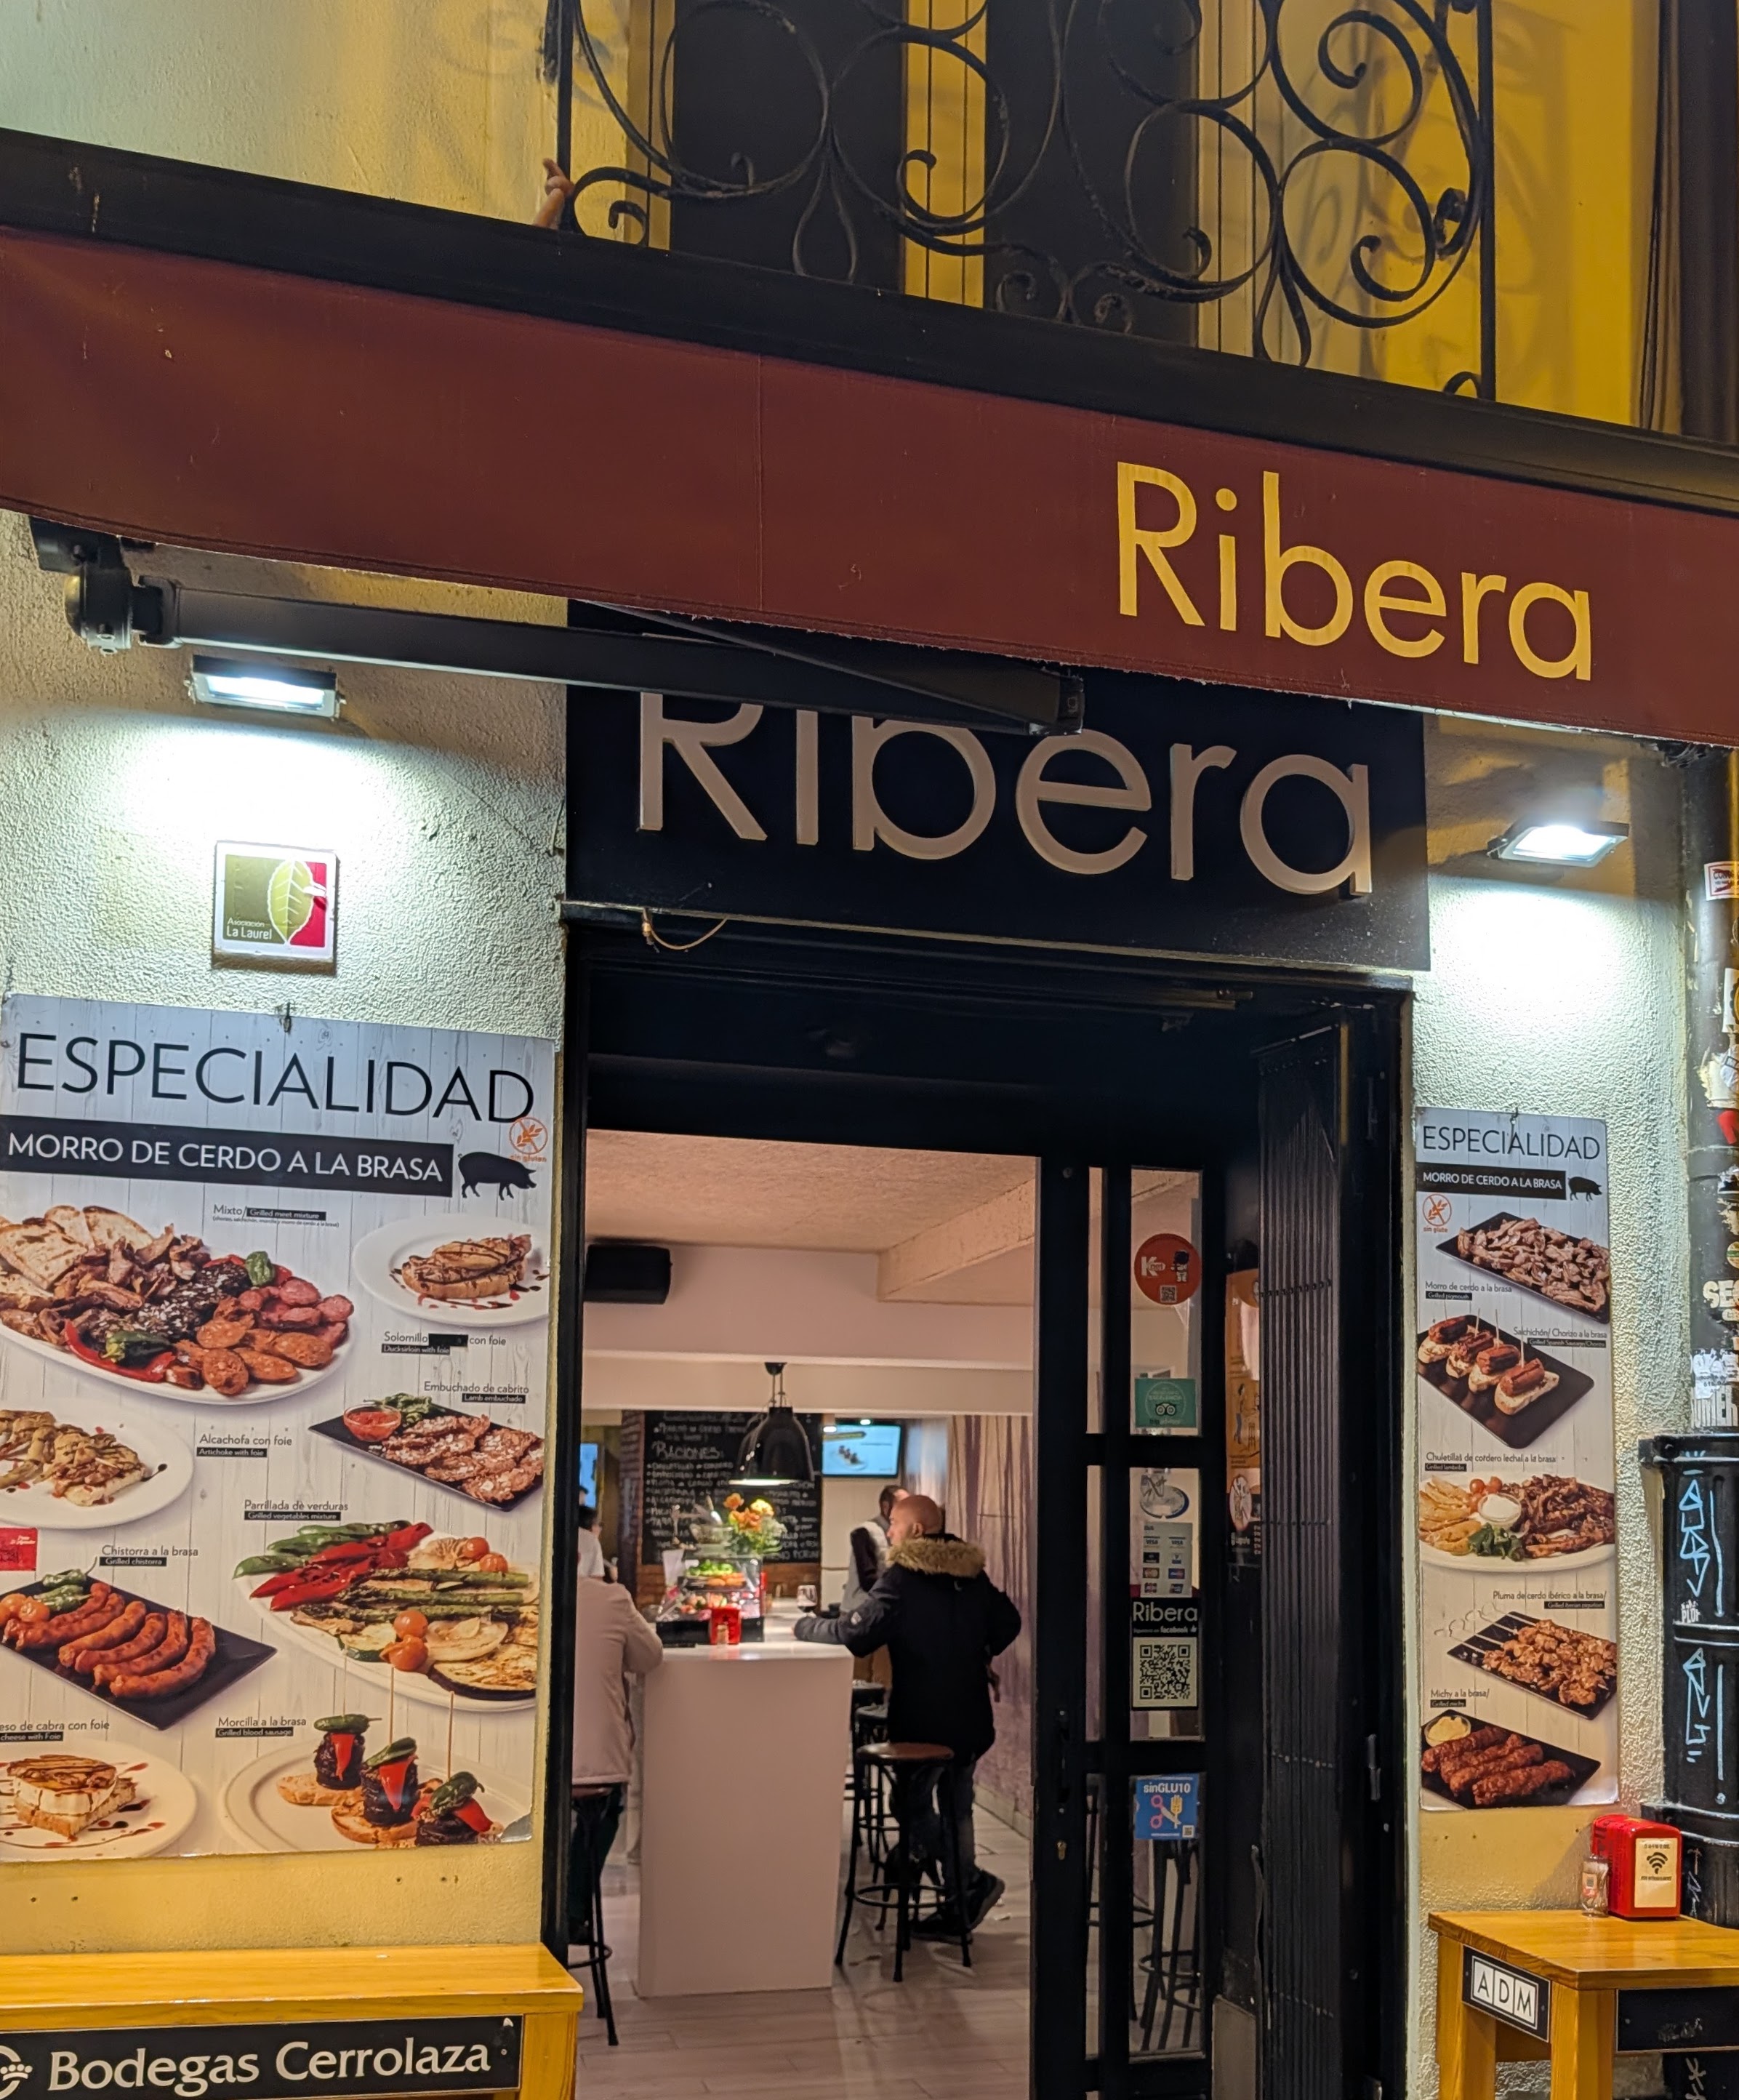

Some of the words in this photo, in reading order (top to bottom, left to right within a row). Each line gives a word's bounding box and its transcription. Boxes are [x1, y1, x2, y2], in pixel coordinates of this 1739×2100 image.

[1117, 461, 1592, 681] Ribera
[638, 692, 1373, 897] Ribera
[227, 926, 238, 937] La
[241, 926, 273, 940] Laurel
[17, 1033, 534, 1123] ESPECIALIDAD
[1423, 1126, 1600, 1160] ESPECIALIDAD
[8, 1131, 124, 1162] MORRO
[132, 1140, 172, 1165] DE
[178, 1143, 281, 1172] CERDO
[287, 1150, 308, 1173] A
[316, 1152, 350, 1176] LA
[357, 1154, 443, 1182] BRASA
[1423, 1172, 1459, 1184] MORRO
[1461, 1174, 1474, 1185] DE
[1476, 1175, 1510, 1187] CERDO
[1511, 1178, 1519, 1187] A
[1519, 1178, 1533, 1188] LA
[1533, 1178, 1562, 1190] BRASA
[249, 1209, 273, 1217] Grilled
[1426, 1281, 1447, 1290] Morro
[1449, 1282, 1458, 1291] de
[1459, 1283, 1479, 1291] cerdo
[1486, 1283, 1493, 1292] la
[1494, 1283, 1512, 1293] brasa
[384, 1331, 427, 1343] Solomillo
[489, 1335, 507, 1345] foie
[1552, 1328, 1578, 1337] Chorizo
[424, 1381, 481, 1392] Embuchado
[483, 1383, 494, 1392] de
[497, 1384, 529, 1393] cabrito
[199, 1433, 250, 1445] Alcachofa
[274, 1435, 292, 1446] foie
[1426, 1452, 1462, 1462] Chuletillas
[1474, 1454, 1501, 1462] cordero
[244, 1499, 289, 1510] Parrillada
[292, 1501, 304, 1510] de
[308, 1501, 348, 1511] verduras
[102, 1544, 149, 1555] Chistorra
[161, 1545, 169, 1555] la
[172, 1546, 198, 1556] brasa
[1493, 1590, 1514, 1600] Pluma
[1517, 1591, 1525, 1600] de
[1527, 1591, 1546, 1600] cerdo
[1549, 1591, 1571, 1600] ibérico
[1133, 1601, 1197, 1622] Ribera
[1461, 1688, 1466, 1697] la
[20, 1720, 33, 1731] de
[36, 1720, 65, 1731] cabra
[90, 1719, 110, 1730] foie
[218, 1717, 258, 1727] Morcilla
[270, 1716, 278, 1726] la
[281, 1716, 307, 1726] brasa
[1144, 1782, 1191, 1794] sinGLU10
[1477, 1971, 1532, 2017] ADM
[47, 2048, 260, 2097] Bodegas
[276, 2036, 491, 2081] Cerrolaza
